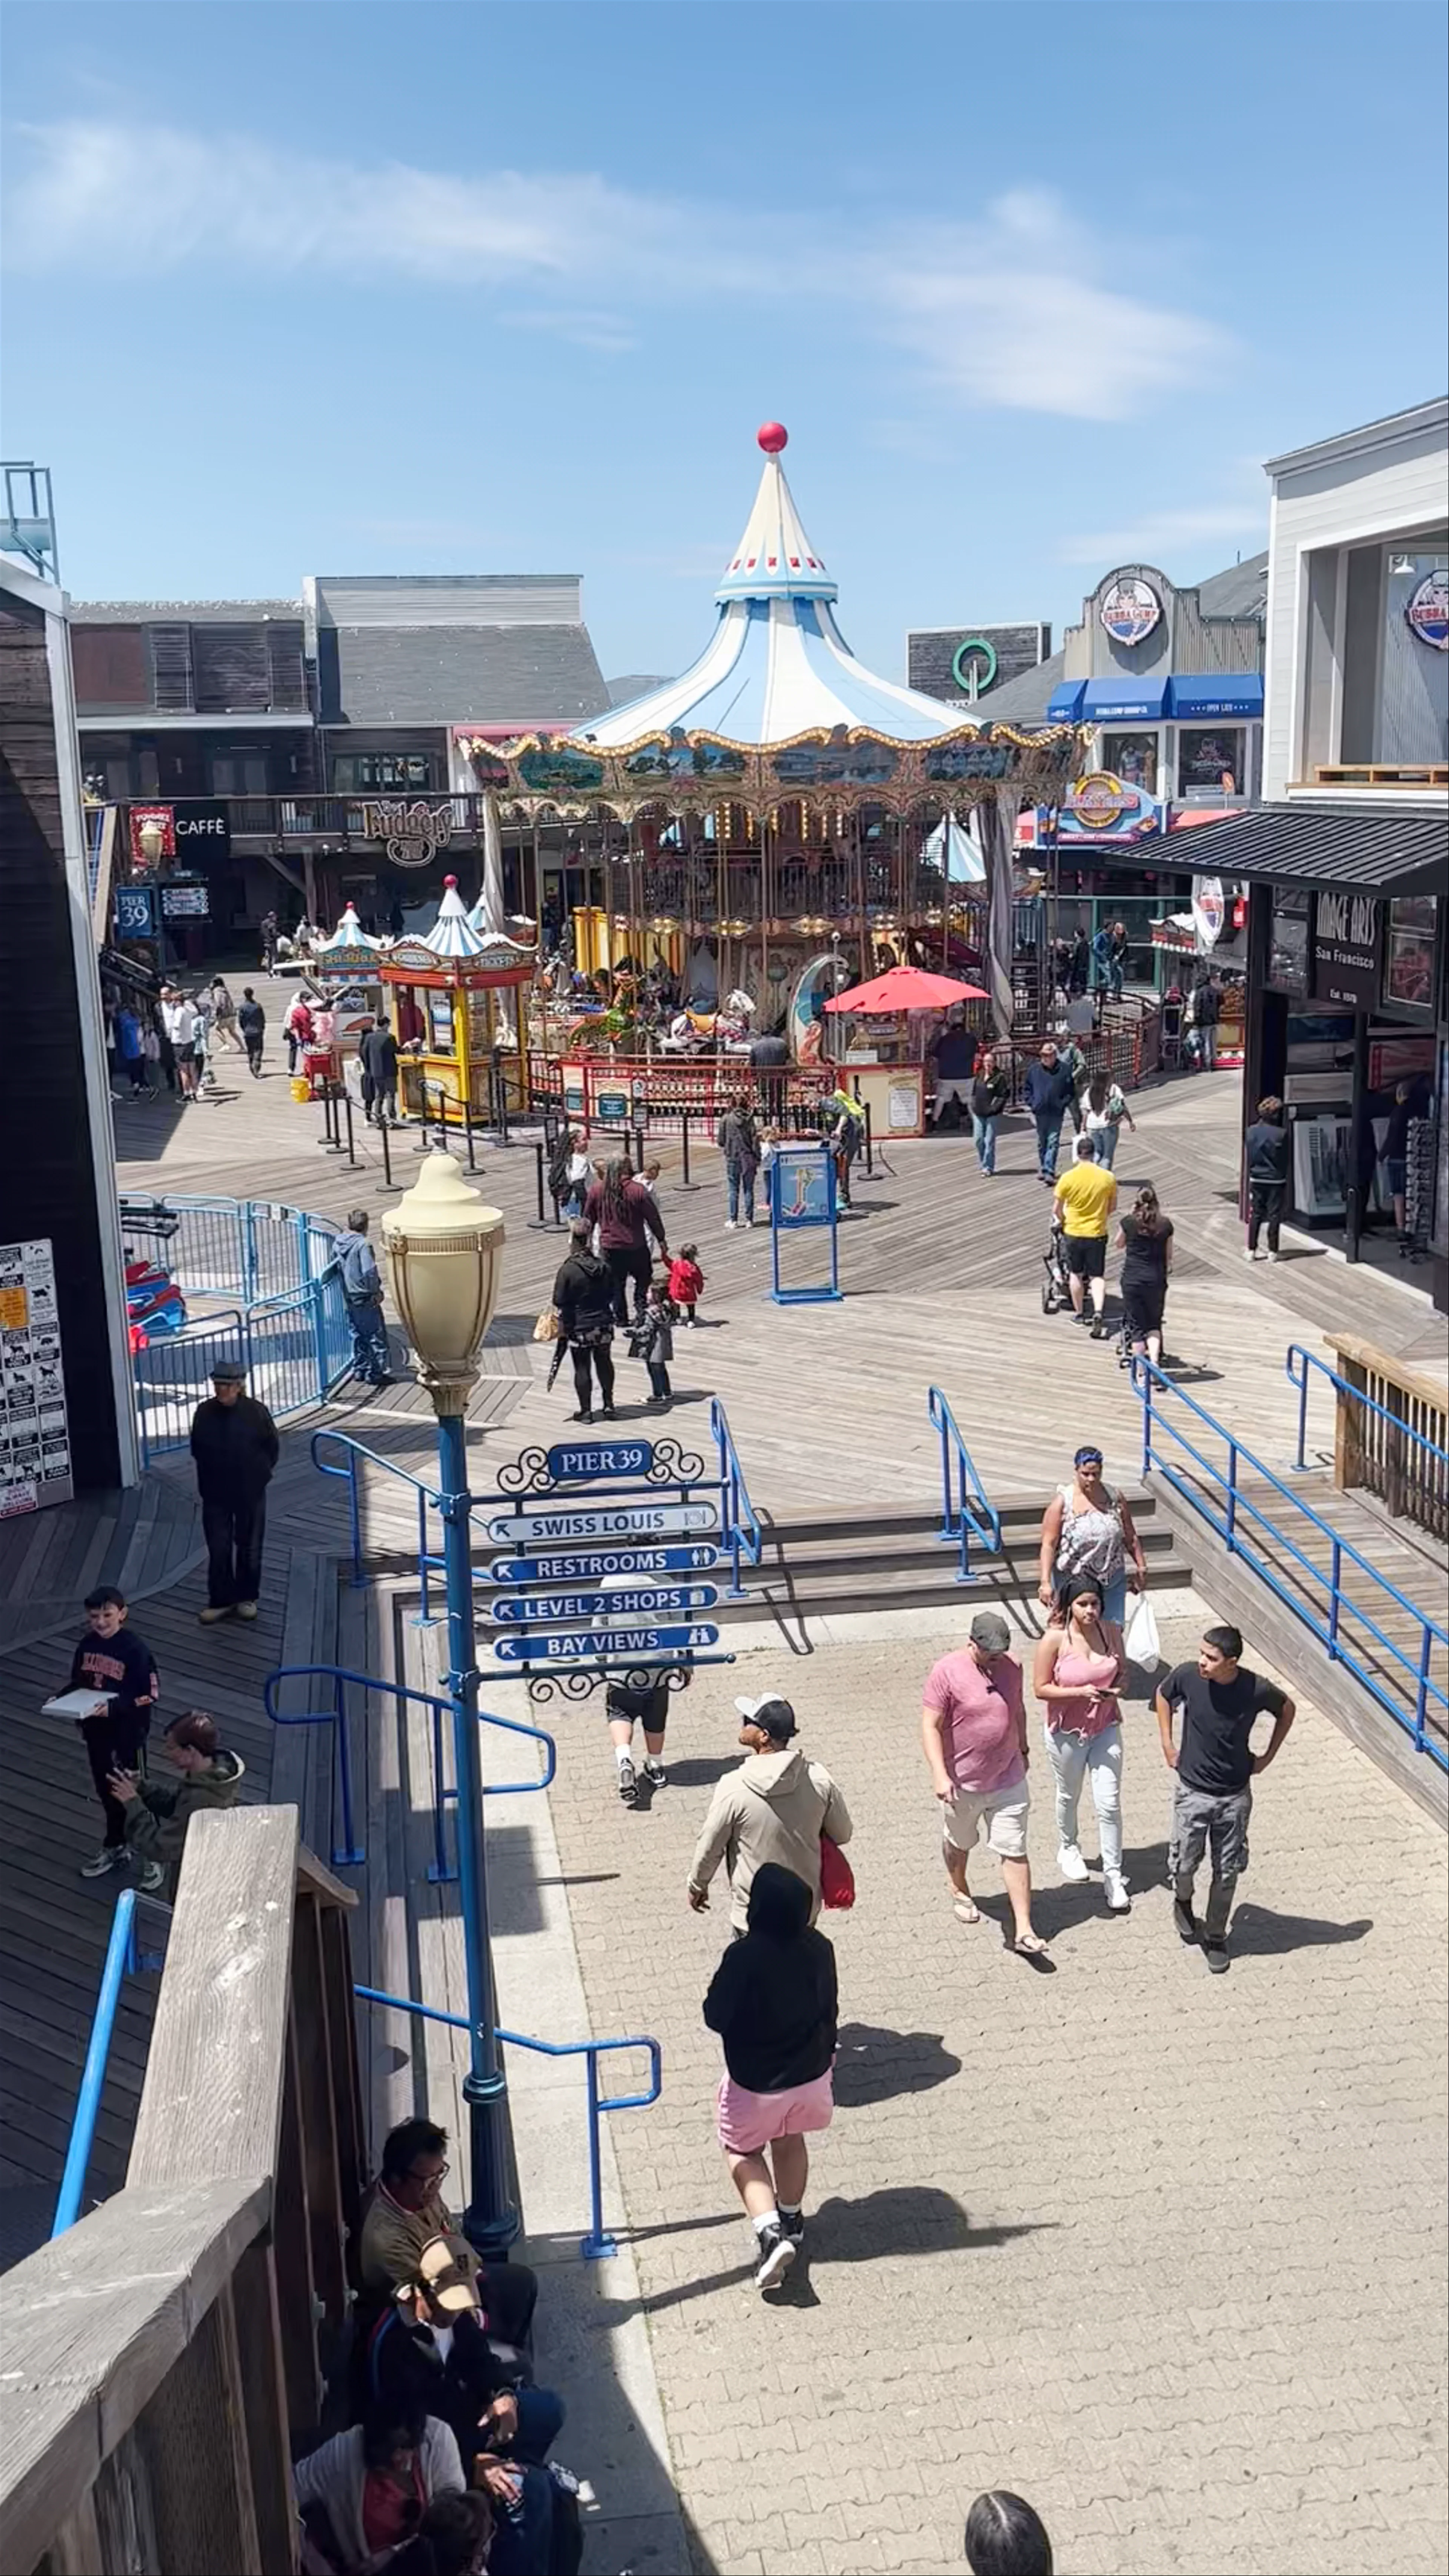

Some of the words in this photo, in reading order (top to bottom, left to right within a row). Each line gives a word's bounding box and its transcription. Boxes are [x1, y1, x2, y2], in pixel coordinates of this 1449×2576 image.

[176, 817, 226, 835] CAFFÈ
[121, 896, 145, 906] PIER
[122, 906, 149, 927] 39
[1315, 946, 1331, 961] San
[1334, 949, 1374, 969] Francisco
[562, 1453, 614, 1472] PIER
[616, 1449, 642, 1469] 39
[532, 1517, 595, 1536] SWISS
[603, 1513, 664, 1532] LOUIS
[538, 1552, 667, 1576] RESTROOMS
[525, 1599, 588, 1618] LEVEL
[594, 1598, 605, 1612] 2
[612, 1590, 680, 1610] SHOPS
[548, 1637, 588, 1655] BAY
[593, 1632, 658, 1652] VIEWS
